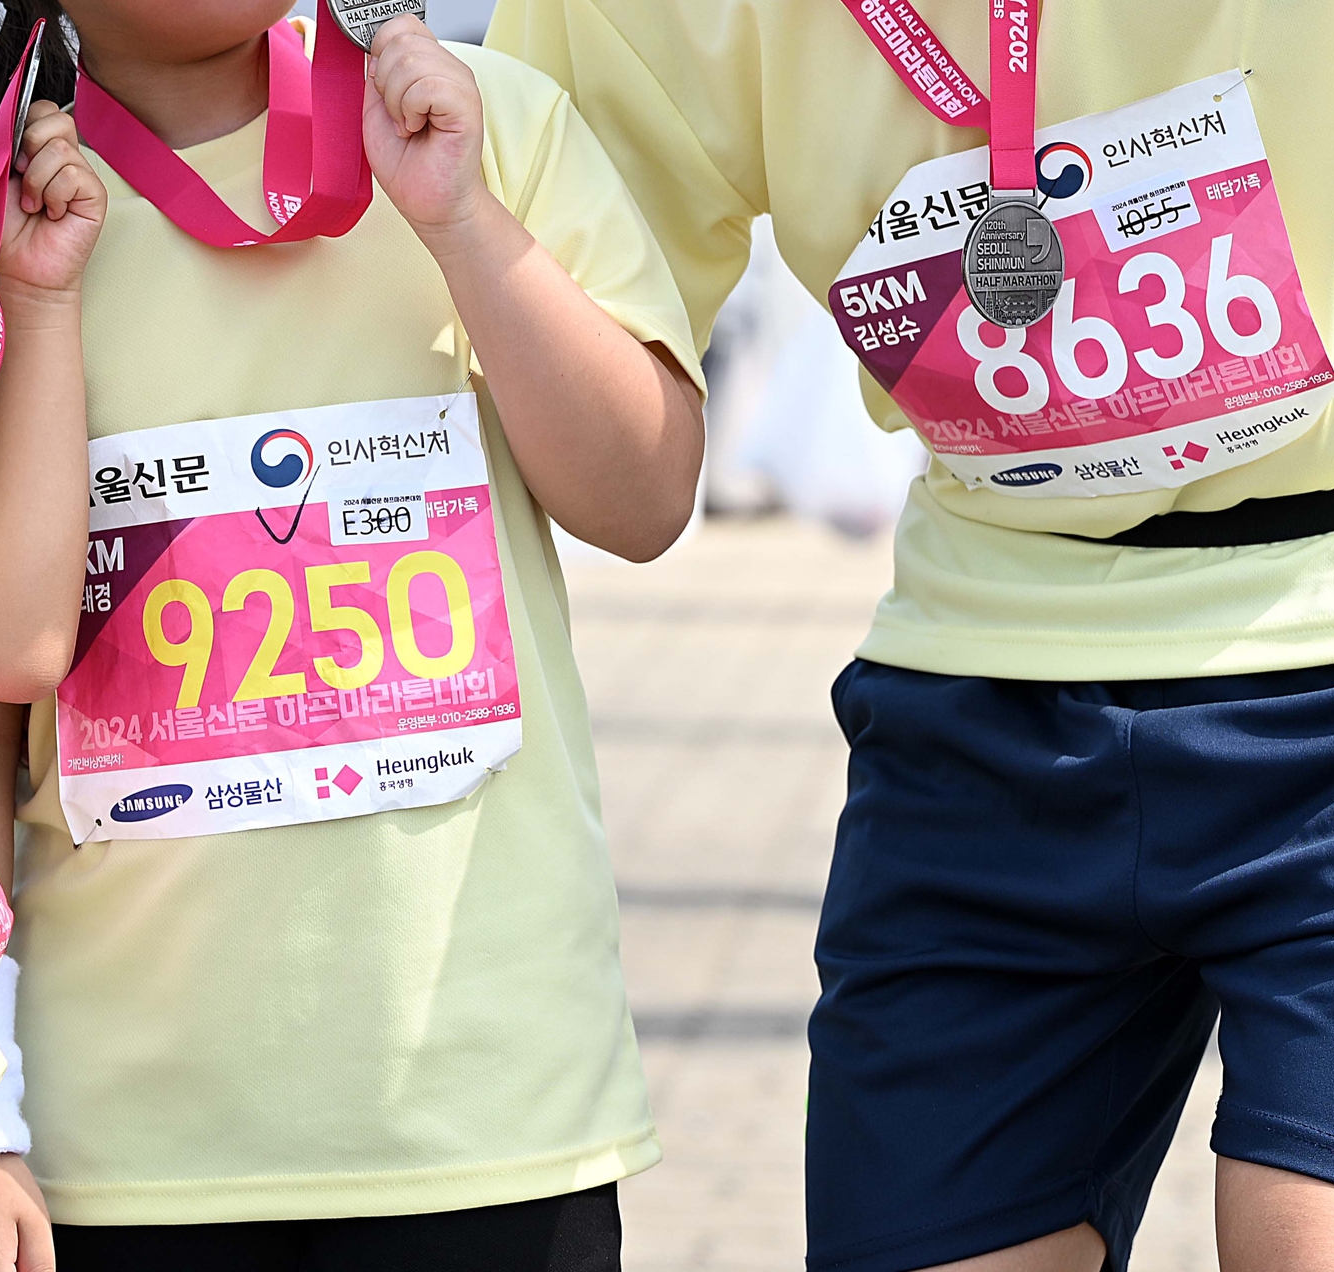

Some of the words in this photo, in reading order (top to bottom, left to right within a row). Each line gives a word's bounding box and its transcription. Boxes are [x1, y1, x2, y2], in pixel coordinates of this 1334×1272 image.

[346, 9, 370, 24] HALF
[893, 2, 926, 41] HALF
[920, 36, 981, 108] MARATHON
[1009, 10, 1029, 72] 2024
[1102, 110, 1227, 168] 인사혁신처
[1205, 172, 1262, 201] 태담가족
[980, 231, 1026, 241] Anniversary
[985, 221, 1006, 230] 120th
[1117, 196, 1180, 239] 1055
[977, 243, 1010, 256] SEOUL
[977, 257, 1025, 271] SHINMUN
[840, 270, 927, 318] 5KM
[976, 277, 1001, 288] HALF
[1002, 274, 1057, 287] MARATHON
[853, 315, 922, 352] 김성수
[956, 233, 1283, 416] 8636
[924, 418, 995, 442] 2024
[1000, 398, 1106, 439] 서울신문
[1110, 341, 1308, 419] 하프마라톤대회
[1215, 407, 1310, 445] Heungkuk
[327, 430, 451, 467] 인사혁신처
[995, 467, 1058, 484] SAMSUNG
[1073, 456, 1143, 482] 삼성물산
[342, 506, 411, 536] E300
[142, 550, 478, 710] 9250
[79, 714, 143, 752] 2024
[149, 698, 268, 742] 서울신문
[274, 667, 497, 729] 하프마라톤대회
[375, 746, 475, 777] Heungkuk
[117, 792, 185, 814] SAMSUNG
[203, 777, 283, 812] 삼성물산
